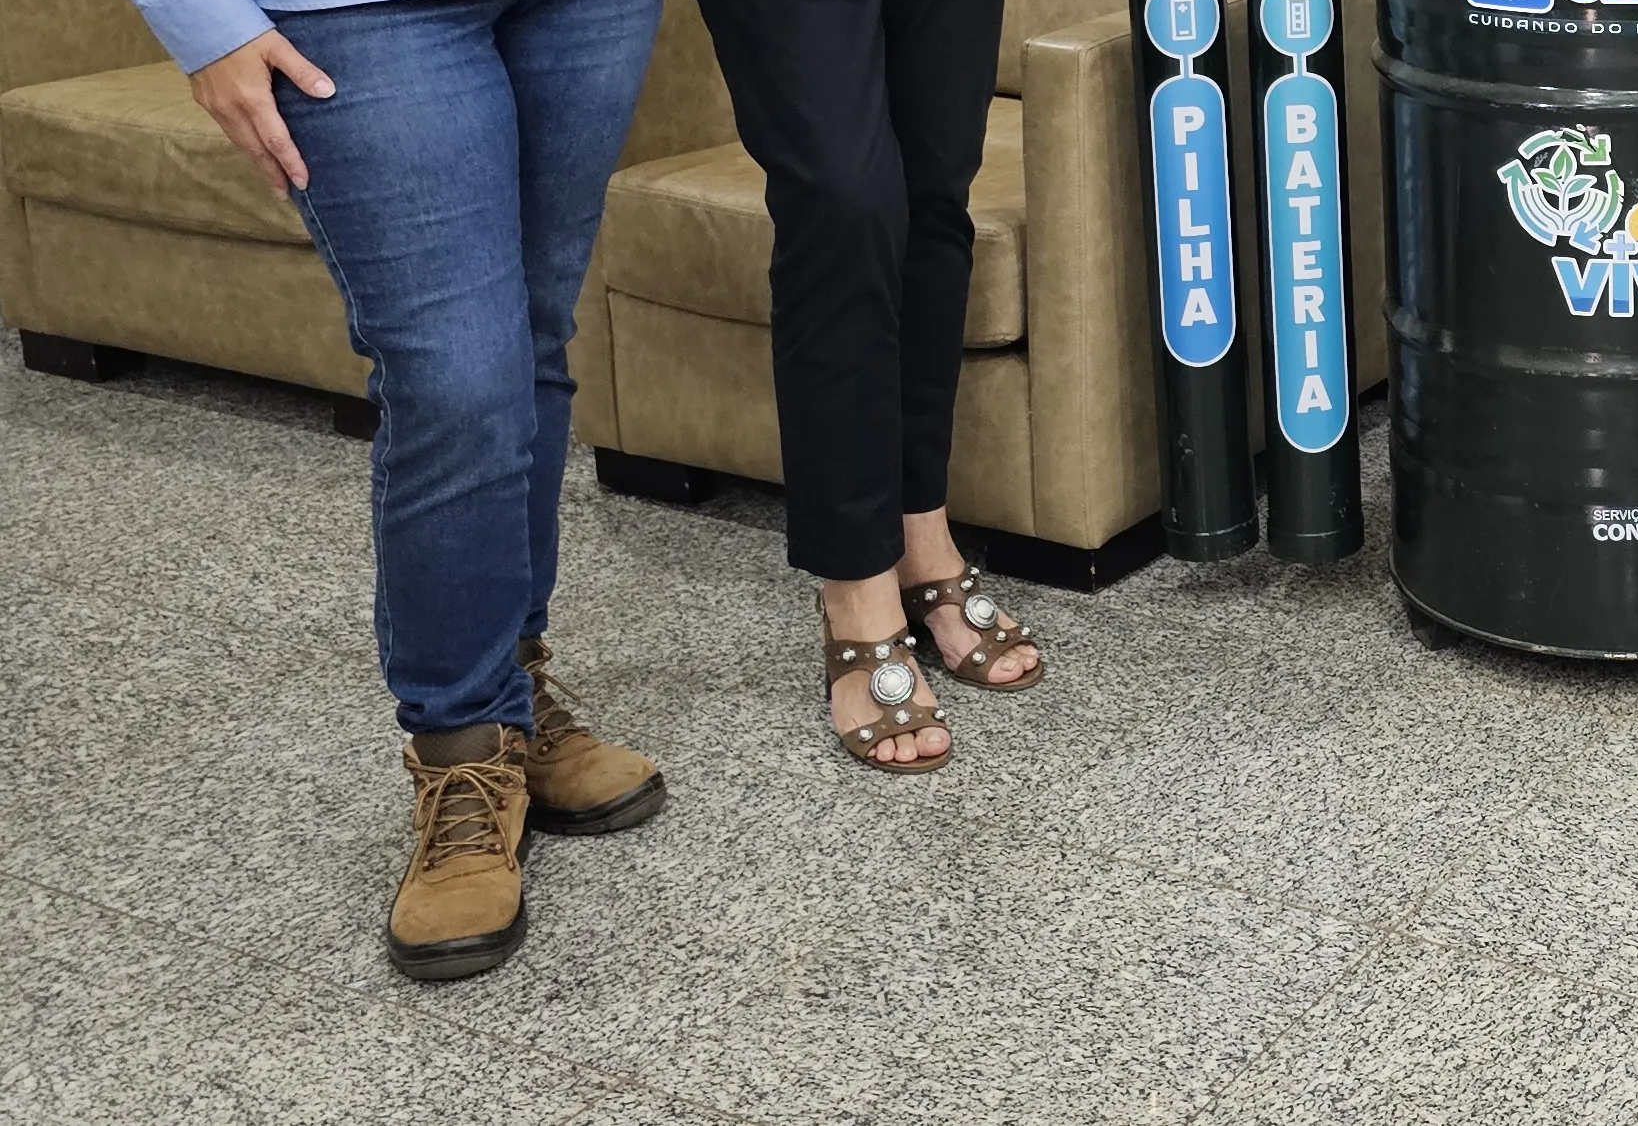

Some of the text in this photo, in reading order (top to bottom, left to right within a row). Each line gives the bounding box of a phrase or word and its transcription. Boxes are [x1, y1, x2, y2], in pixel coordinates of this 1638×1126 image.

[1468, 12, 1577, 34] CUIDANDO
[1592, 23, 1622, 34] DO
[1170, 106, 1217, 327] PILHA
[1285, 104, 1332, 414] BATERIA
